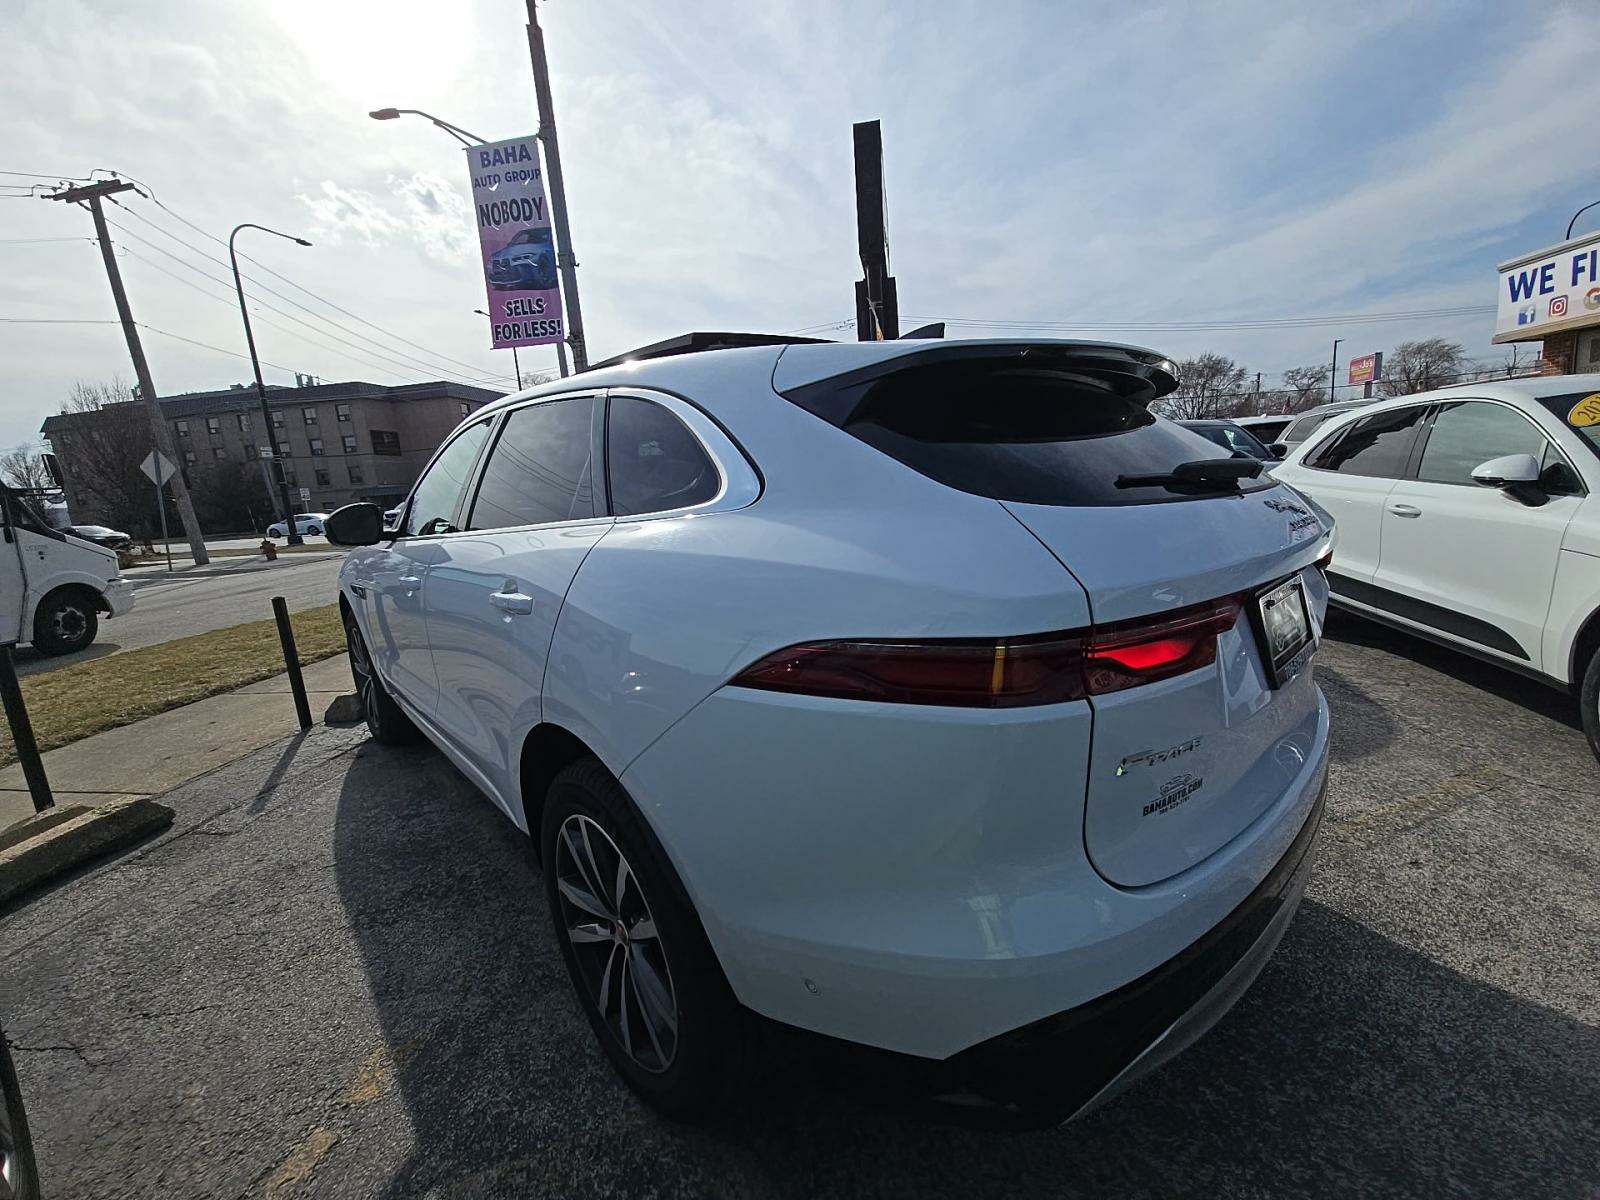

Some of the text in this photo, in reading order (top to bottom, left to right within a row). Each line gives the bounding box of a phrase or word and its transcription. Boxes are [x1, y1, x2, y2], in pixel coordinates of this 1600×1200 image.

[480, 143, 532, 169] BAHA
[474, 168, 541, 188] AUTO GROUP
[480, 196, 543, 227] NOBODY
[1508, 249, 1598, 303] WE FI
[505, 298, 545, 317] SELLS
[494, 319, 561, 341] FOR LESS!
